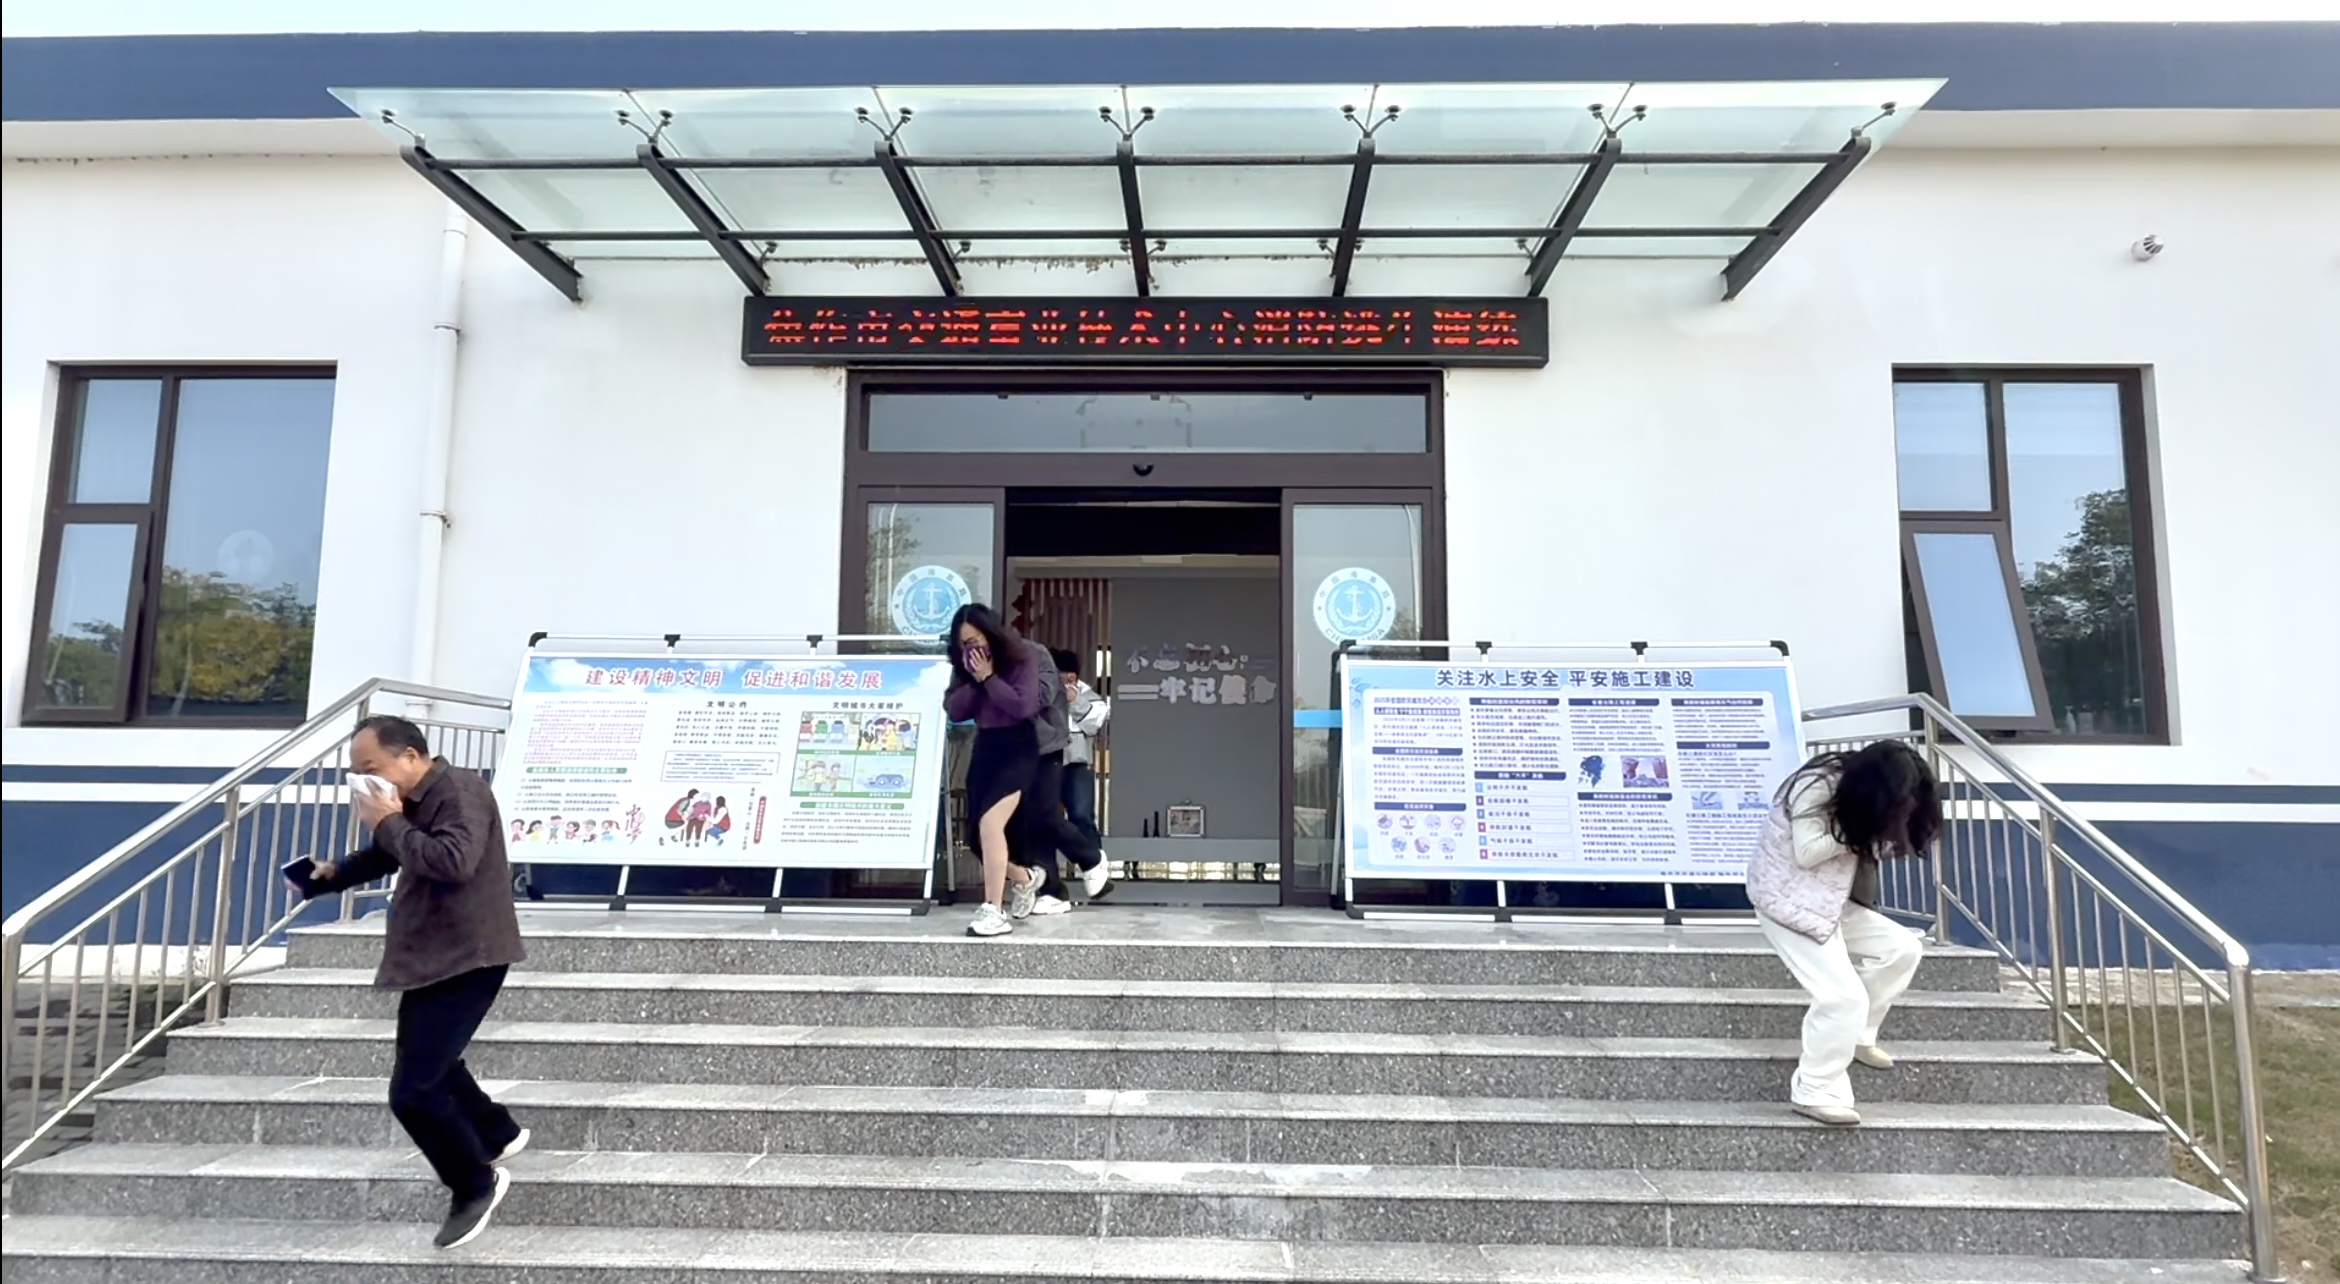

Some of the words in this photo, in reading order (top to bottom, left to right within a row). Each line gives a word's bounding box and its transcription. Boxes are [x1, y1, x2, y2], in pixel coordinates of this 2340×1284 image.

[585, 669, 724, 688] 建设精神文明
[742, 671, 884, 690] 促进和谐发展
[1436, 669, 1560, 687] 关注水上安全
[1568, 670, 1695, 688] 平安施工建设
